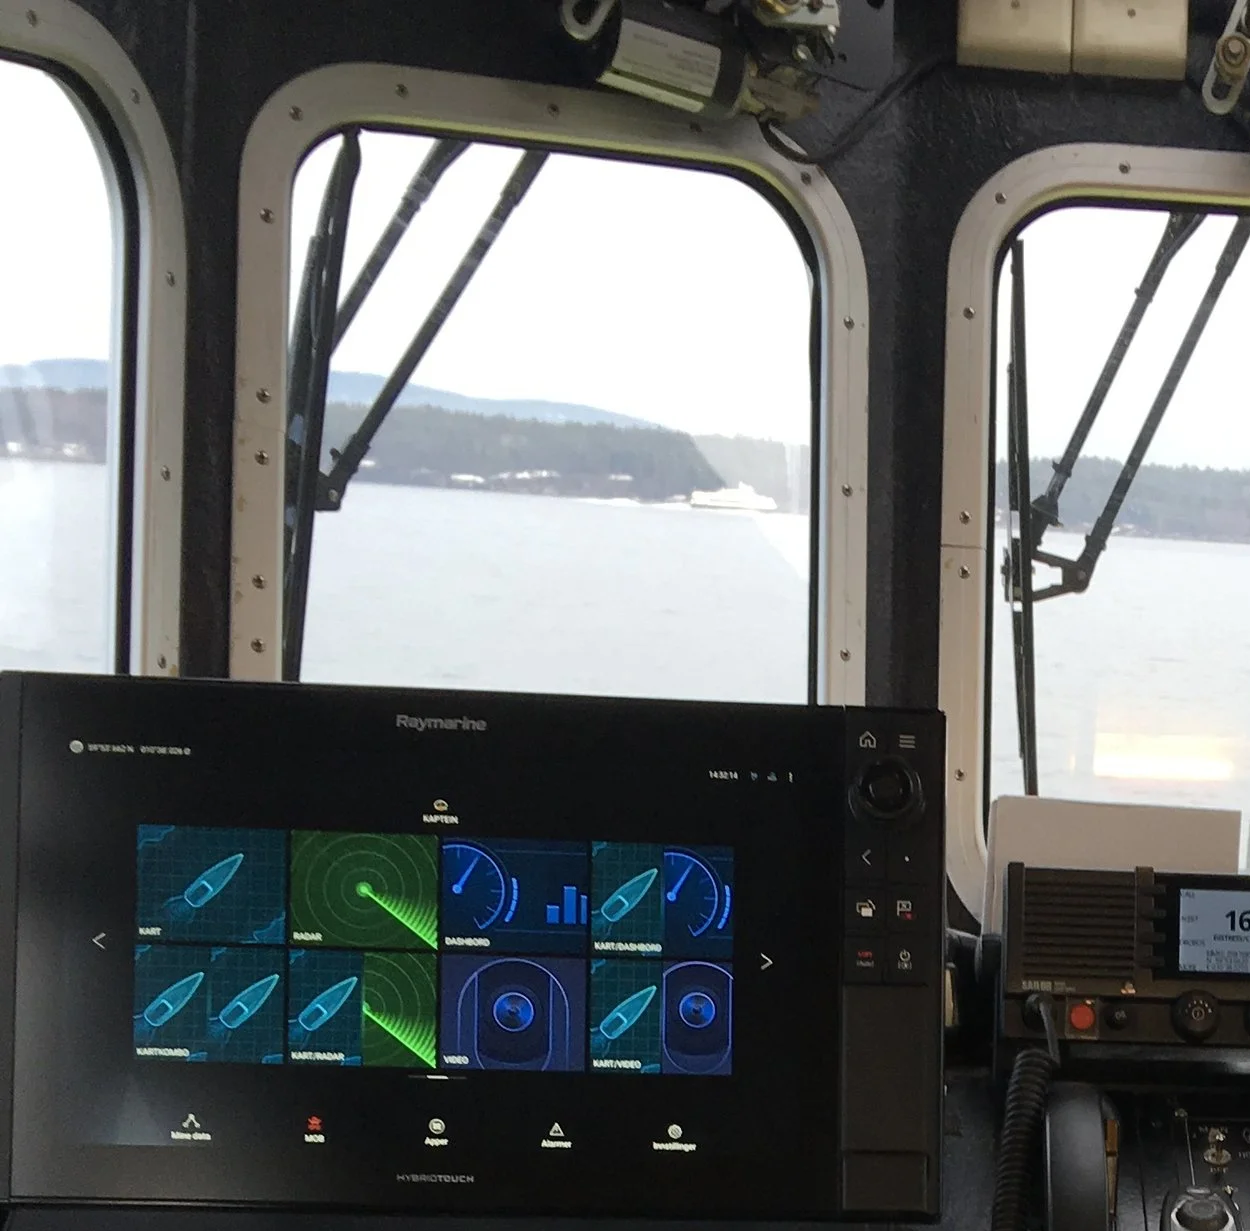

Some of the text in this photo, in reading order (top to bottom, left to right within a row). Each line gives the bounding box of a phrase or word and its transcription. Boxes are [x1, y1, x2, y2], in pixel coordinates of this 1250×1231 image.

[396, 714, 487, 732] Raymarine
[138, 926, 162, 937] KART
[293, 931, 322, 942] RADAR
[443, 1055, 470, 1065] VIDEO
[593, 1059, 642, 1070] KART/VIDEO
[396, 1173, 475, 1184] HYBRIDTOUCH
